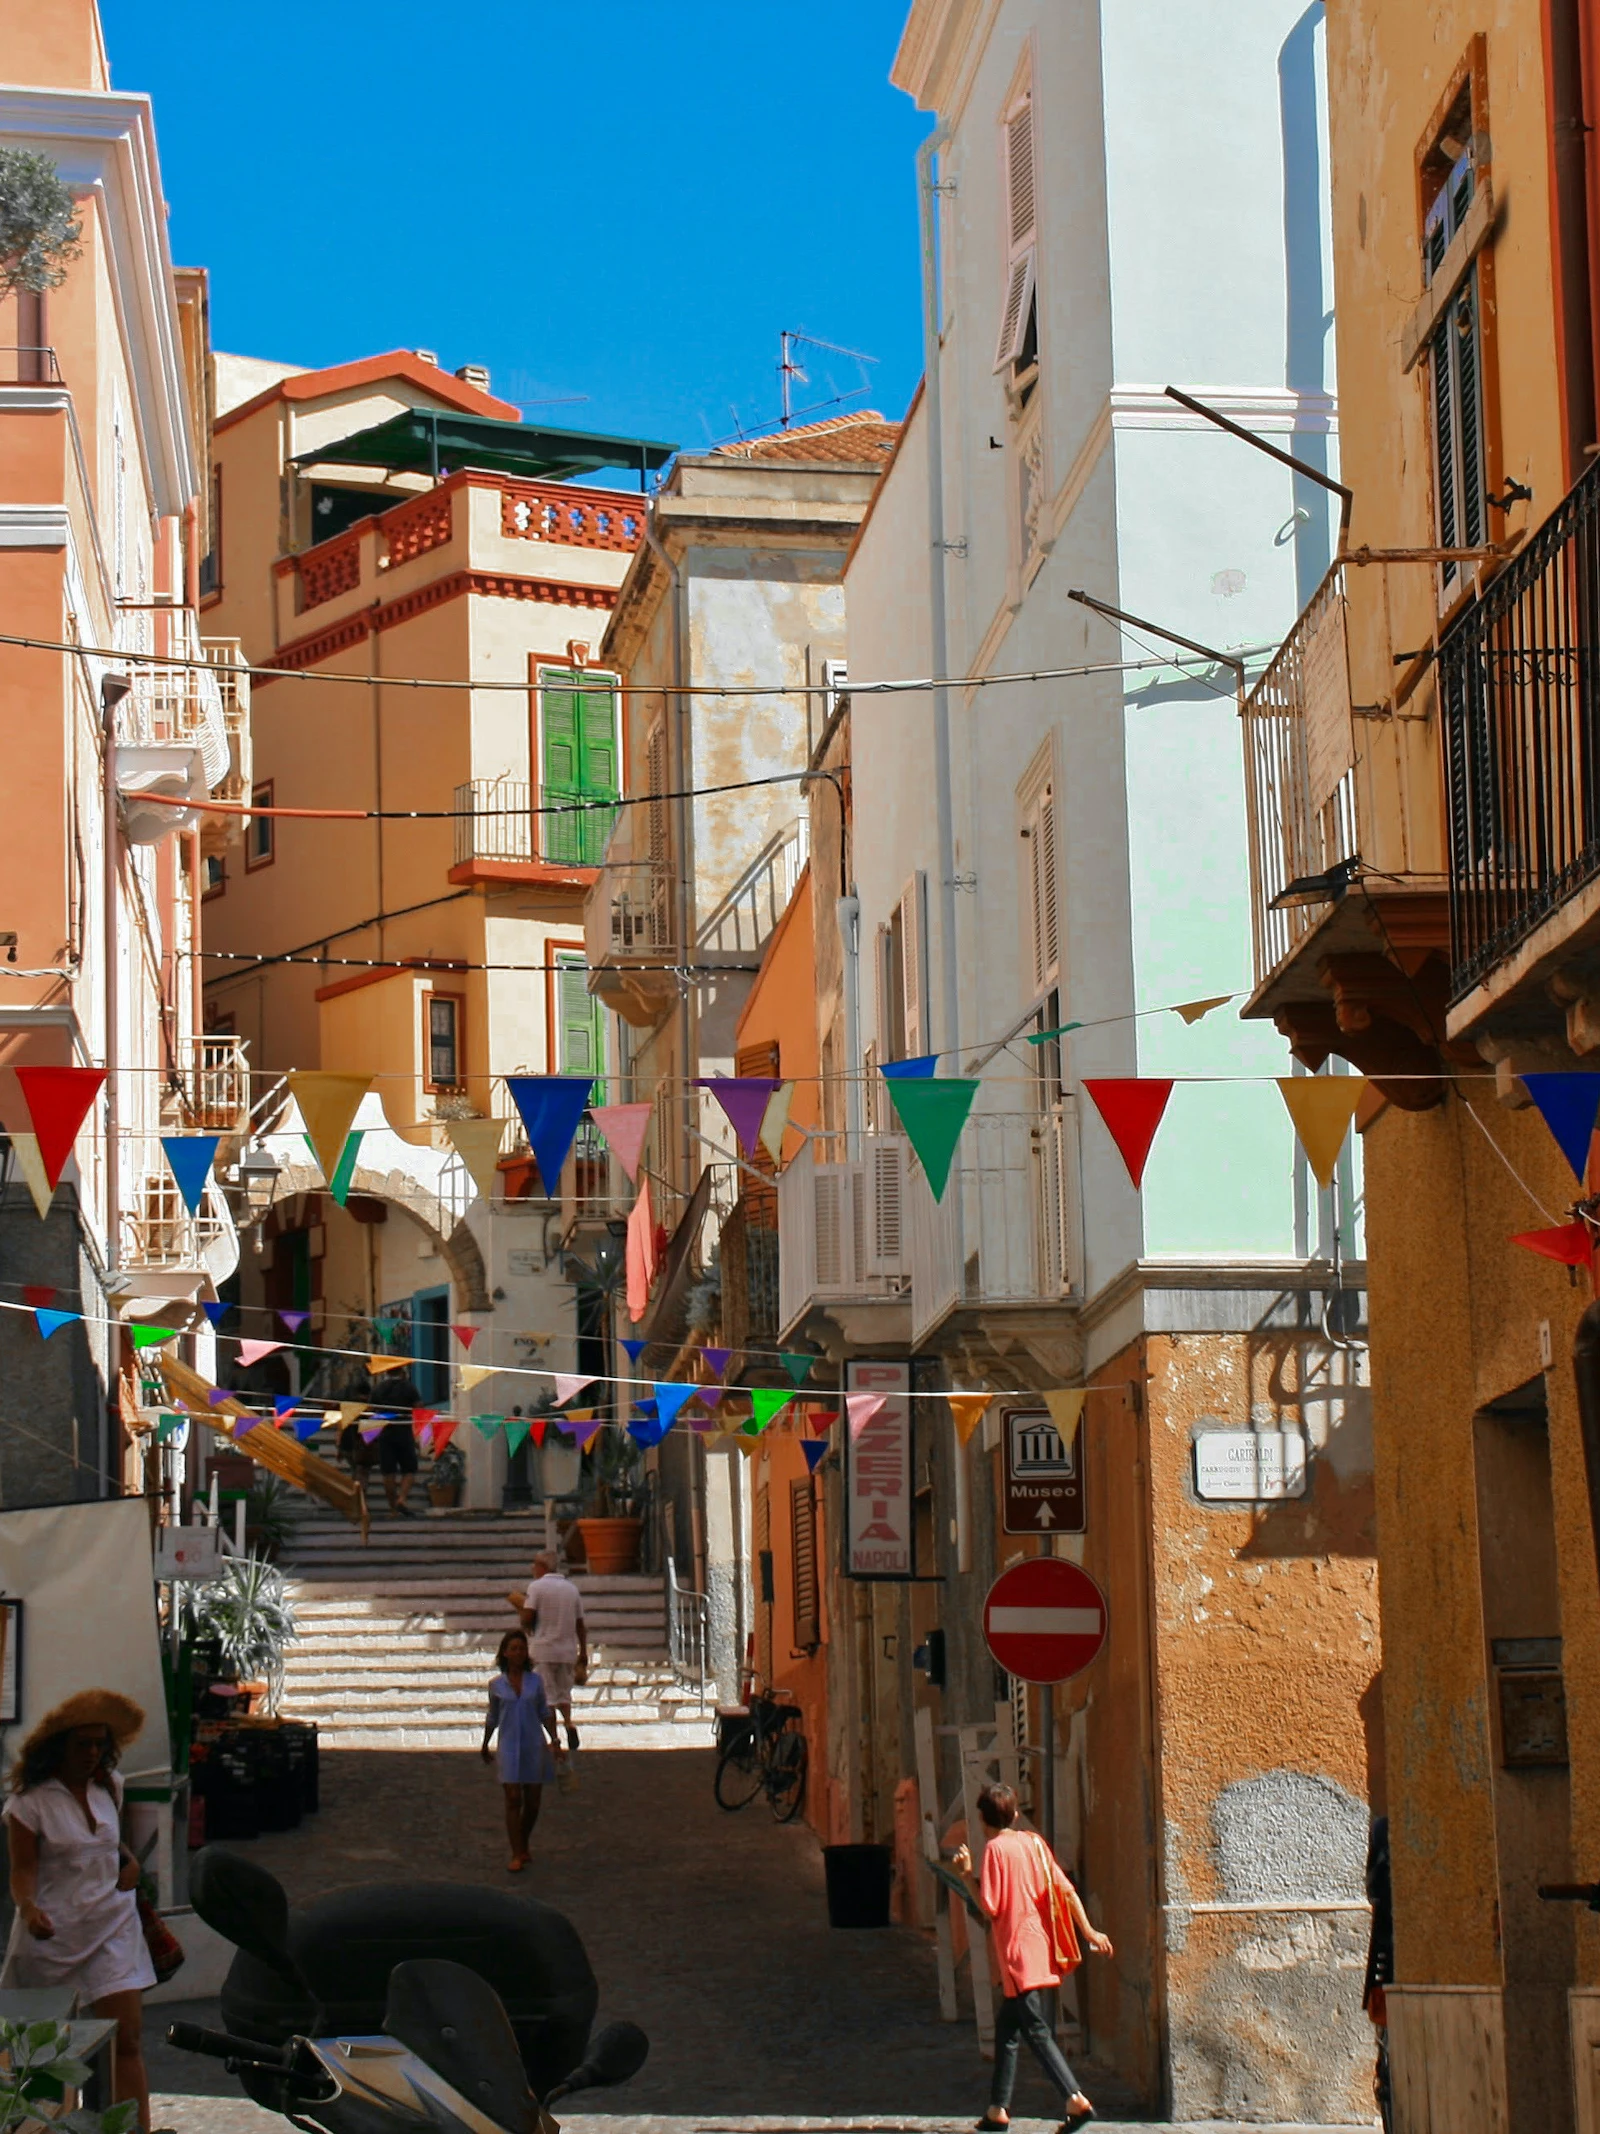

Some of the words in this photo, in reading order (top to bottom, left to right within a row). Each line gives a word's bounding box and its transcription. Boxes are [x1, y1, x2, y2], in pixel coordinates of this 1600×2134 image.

[855, 1367, 903, 1541] PZZERIA
[1227, 1447, 1275, 1461] GARIBALDI
[1011, 1485, 1077, 1498] Museo
[852, 1550, 908, 1570] NAPOLI
